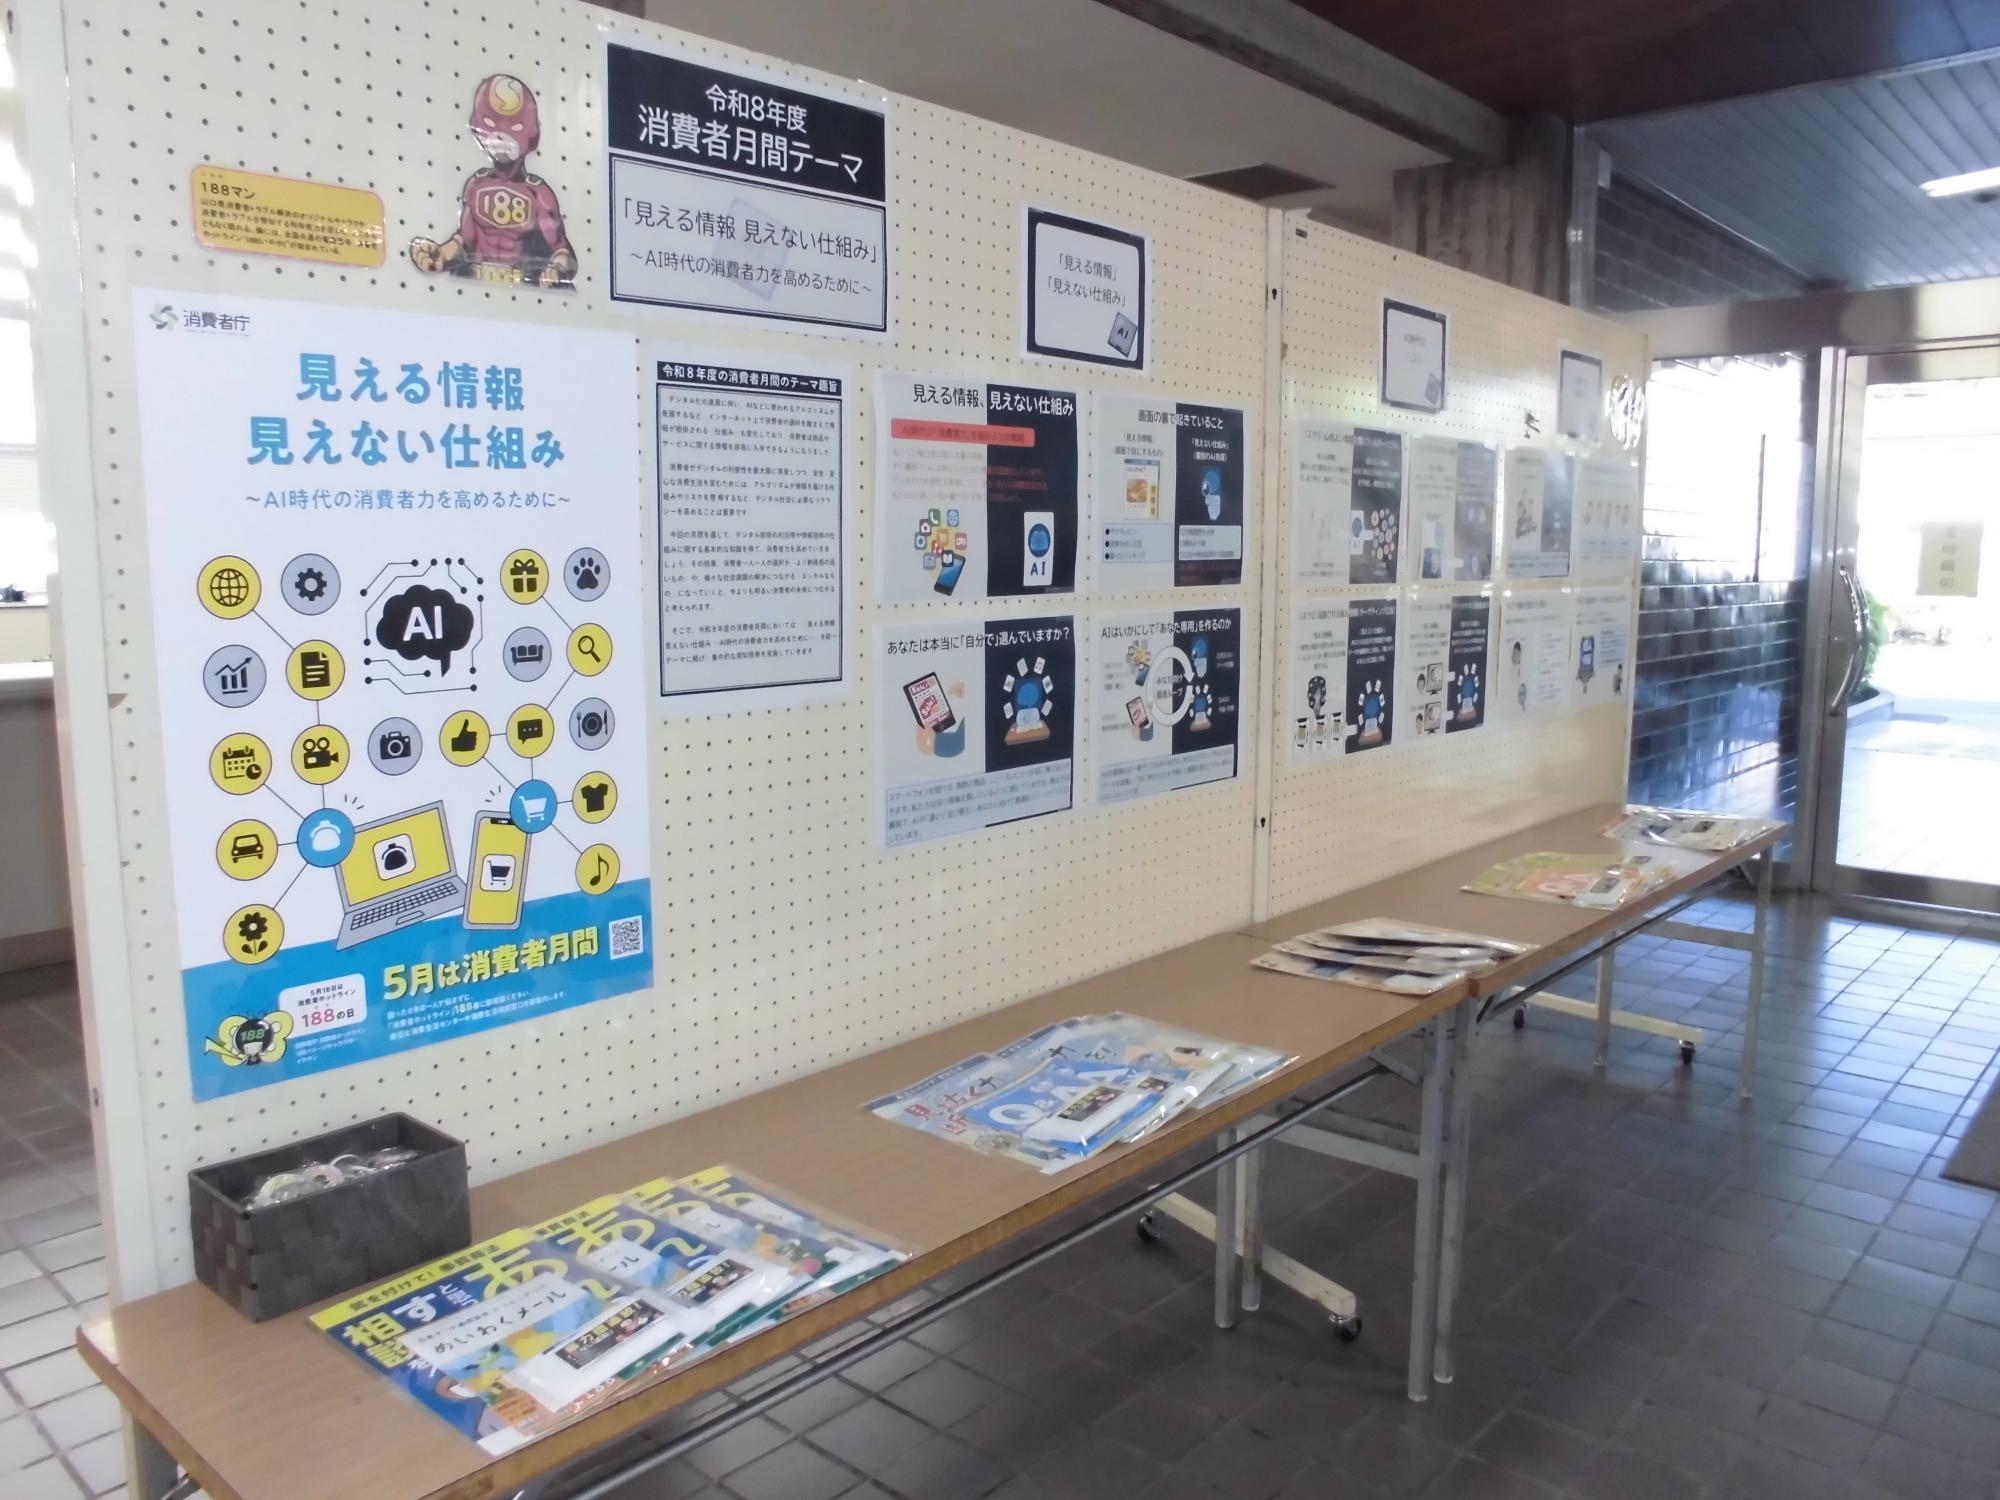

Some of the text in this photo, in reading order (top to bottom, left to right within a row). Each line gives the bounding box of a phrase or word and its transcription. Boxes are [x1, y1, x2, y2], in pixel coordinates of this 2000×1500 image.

[705, 83, 809, 135] 令和8年度
[638, 103, 864, 184] 消費者月間テーマ
[201, 181, 256, 200] 188マン
[481, 188, 530, 228] 188
[623, 197, 878, 264] 「見える情報 見えない仕組み」
[1058, 252, 1118, 282] 「見える情報」
[1048, 277, 1127, 308] 「見えない仕組み」
[183, 309, 250, 331] 消費者庁
[296, 352, 526, 412] 見える情報
[913, 383, 1074, 417] 見える情報、見えない仕組み
[246, 415, 566, 472] 見えない仕組み
[1029, 562, 1047, 576] AI
[402, 605, 443, 642] AI
[382, 926, 600, 1001] 5月は消費者月間
[240, 1027, 267, 1042] 188
[301, 1008, 355, 1028] 188の日
[434, 1287, 568, 1355] めいわくメール
